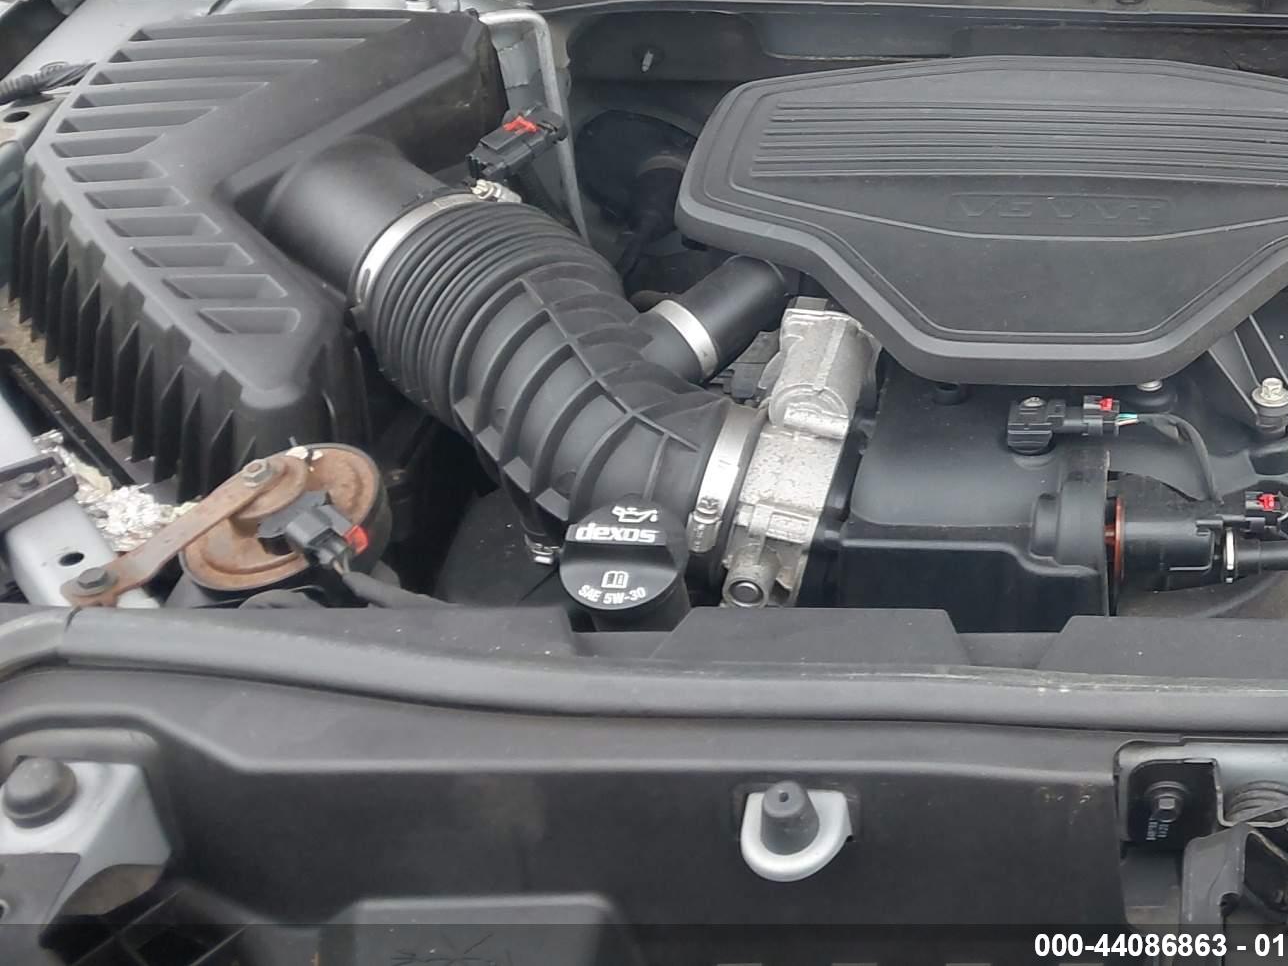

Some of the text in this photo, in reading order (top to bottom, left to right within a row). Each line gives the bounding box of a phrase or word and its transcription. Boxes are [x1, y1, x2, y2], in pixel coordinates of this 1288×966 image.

[575, 522, 661, 543] dexos
[578, 585, 647, 605] SAE 5W-30
